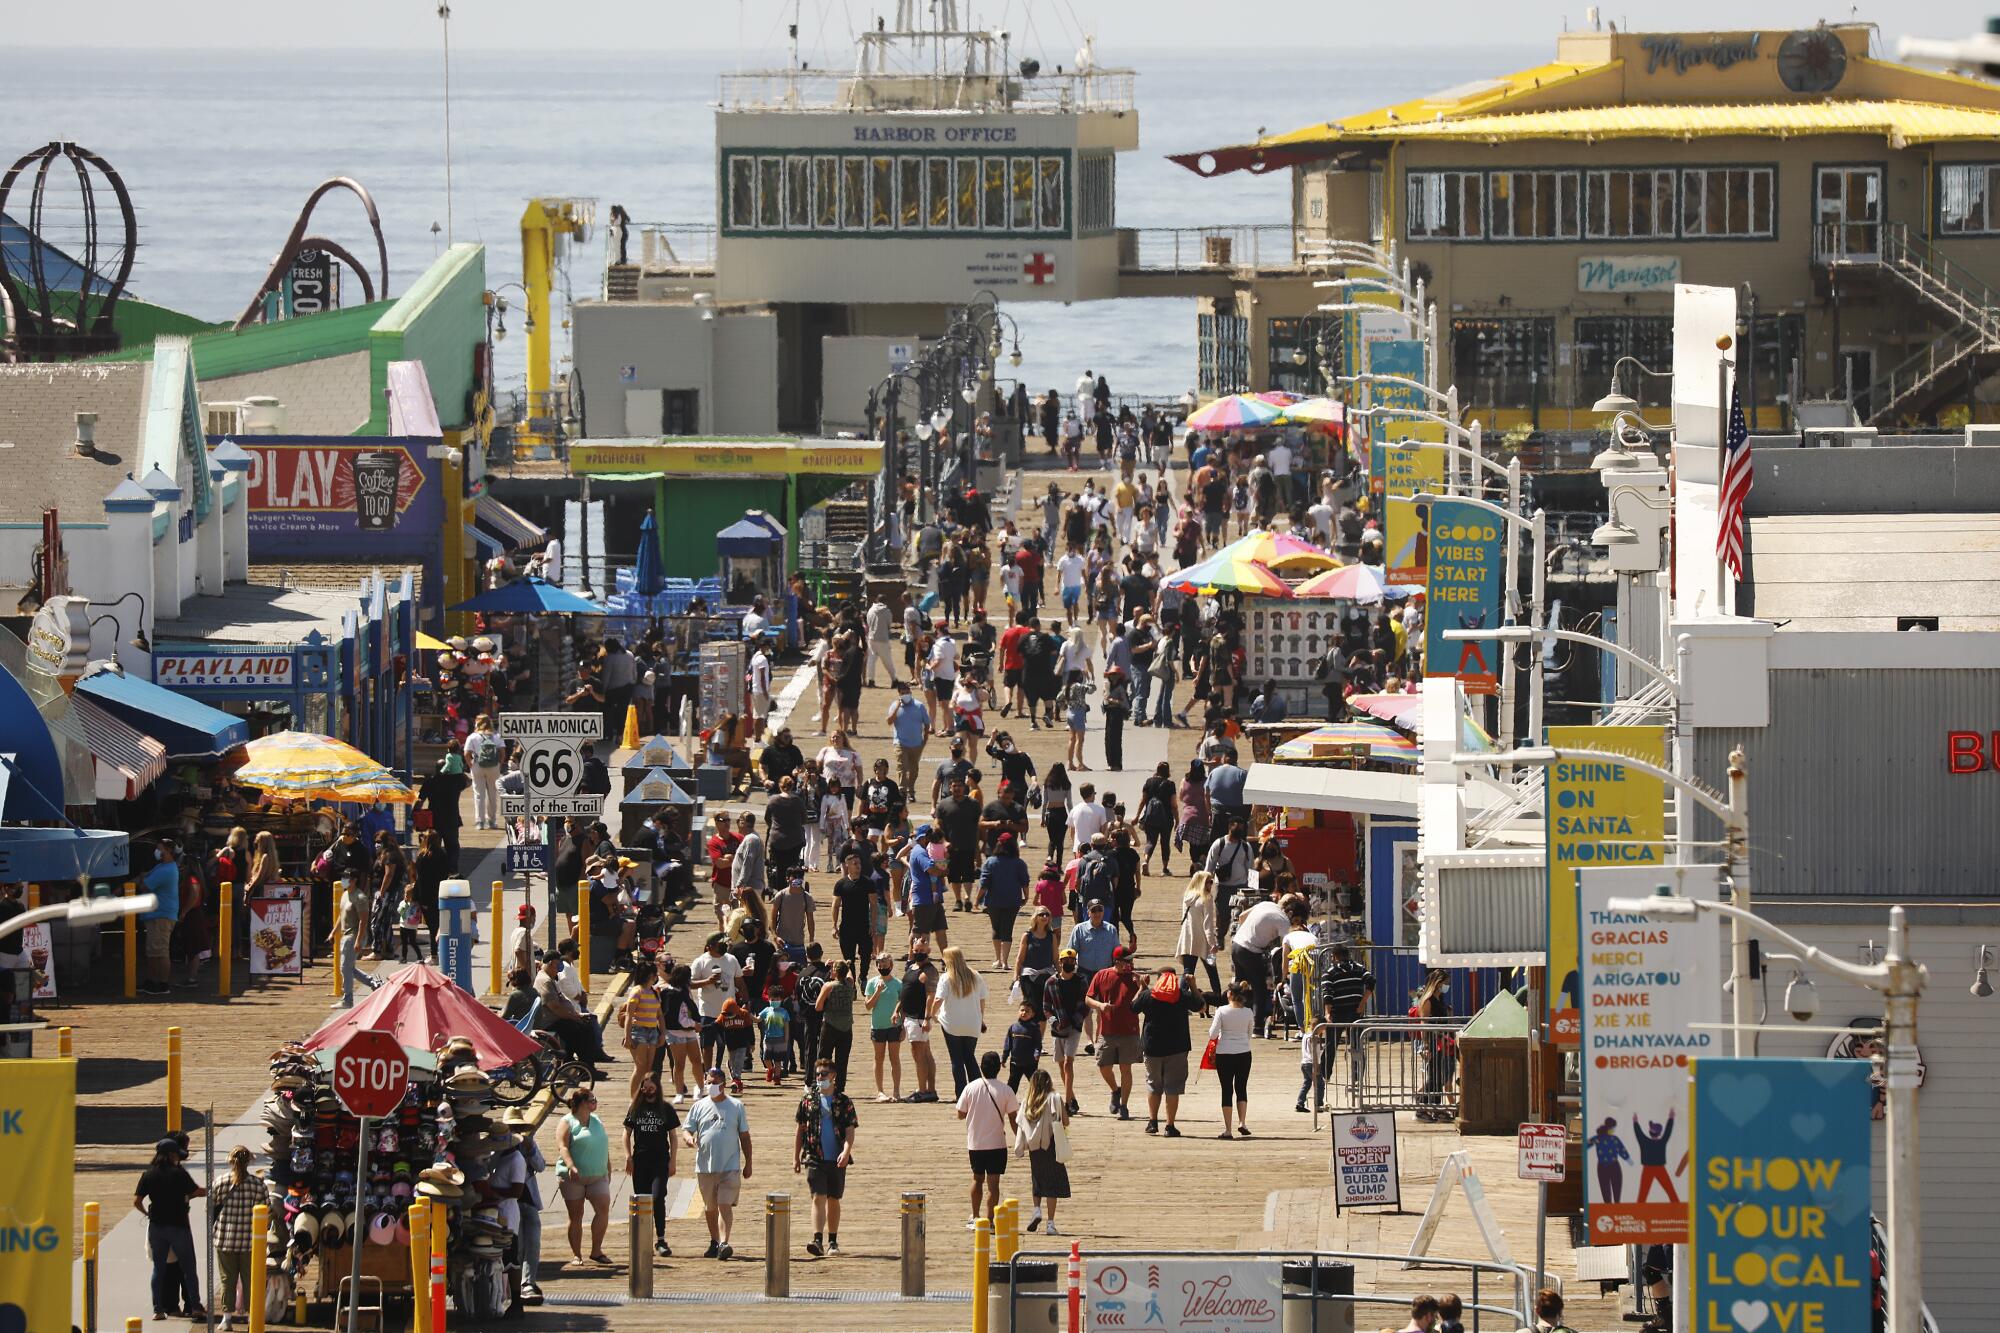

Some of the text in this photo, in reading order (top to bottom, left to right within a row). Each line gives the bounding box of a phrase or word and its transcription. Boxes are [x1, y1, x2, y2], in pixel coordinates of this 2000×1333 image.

[1641, 32, 1760, 76] Mariasol
[854, 127, 1017, 142] HARBOR OFFICE
[292, 268, 323, 279] FRESH
[1580, 260, 1678, 289] Mariasol
[1390, 452, 1412, 461] YOU
[1390, 464, 1412, 475] FOR
[358, 469, 395, 494] Coffee
[364, 495, 390, 516] TO GO
[1435, 525, 1497, 542] GOOD
[1435, 546, 1485, 561] VIBES
[1434, 565, 1487, 582] START
[1433, 586, 1479, 602] HERE
[160, 658, 290, 676] PLAYLAND
[179, 676, 271, 684] ARCADE
[503, 719, 598, 734] SANTA MONICA
[1948, 731, 2000, 774] B
[529, 749, 574, 788] 66
[1557, 764, 1626, 782] SHINE
[533, 799, 546, 812] of
[548, 800, 568, 812] the
[573, 800, 598, 812] Trail
[1557, 790, 1595, 809] ON
[1556, 816, 1633, 835] SANTA
[1556, 843, 1655, 861] MONICA
[1591, 931, 1669, 945] GRACIAS
[1592, 952, 1643, 965] MERCI
[1593, 972, 1680, 986] ARIGATOU
[1592, 993, 1650, 1007] DANKE
[1594, 1034, 1711, 1048] DHANYAVAAD
[1595, 1054, 1689, 1069] OBRIGADO
[338, 1056, 405, 1091] STOP
[1520, 1135, 1562, 1149] NO STOPPING
[1339, 1146, 1389, 1155] DINING ROOM
[1525, 1152, 1558, 1161] ANY TIME
[1346, 1152, 1385, 1165] OPEN
[1344, 1174, 1388, 1185] BUBBA
[1707, 1156, 1842, 1192] SHOW
[1347, 1184, 1386, 1195] GUMP
[1707, 1203, 1826, 1239] YOUR
[1708, 1252, 1861, 1287] LOCAL
[1181, 1275, 1276, 1324] Welcome
